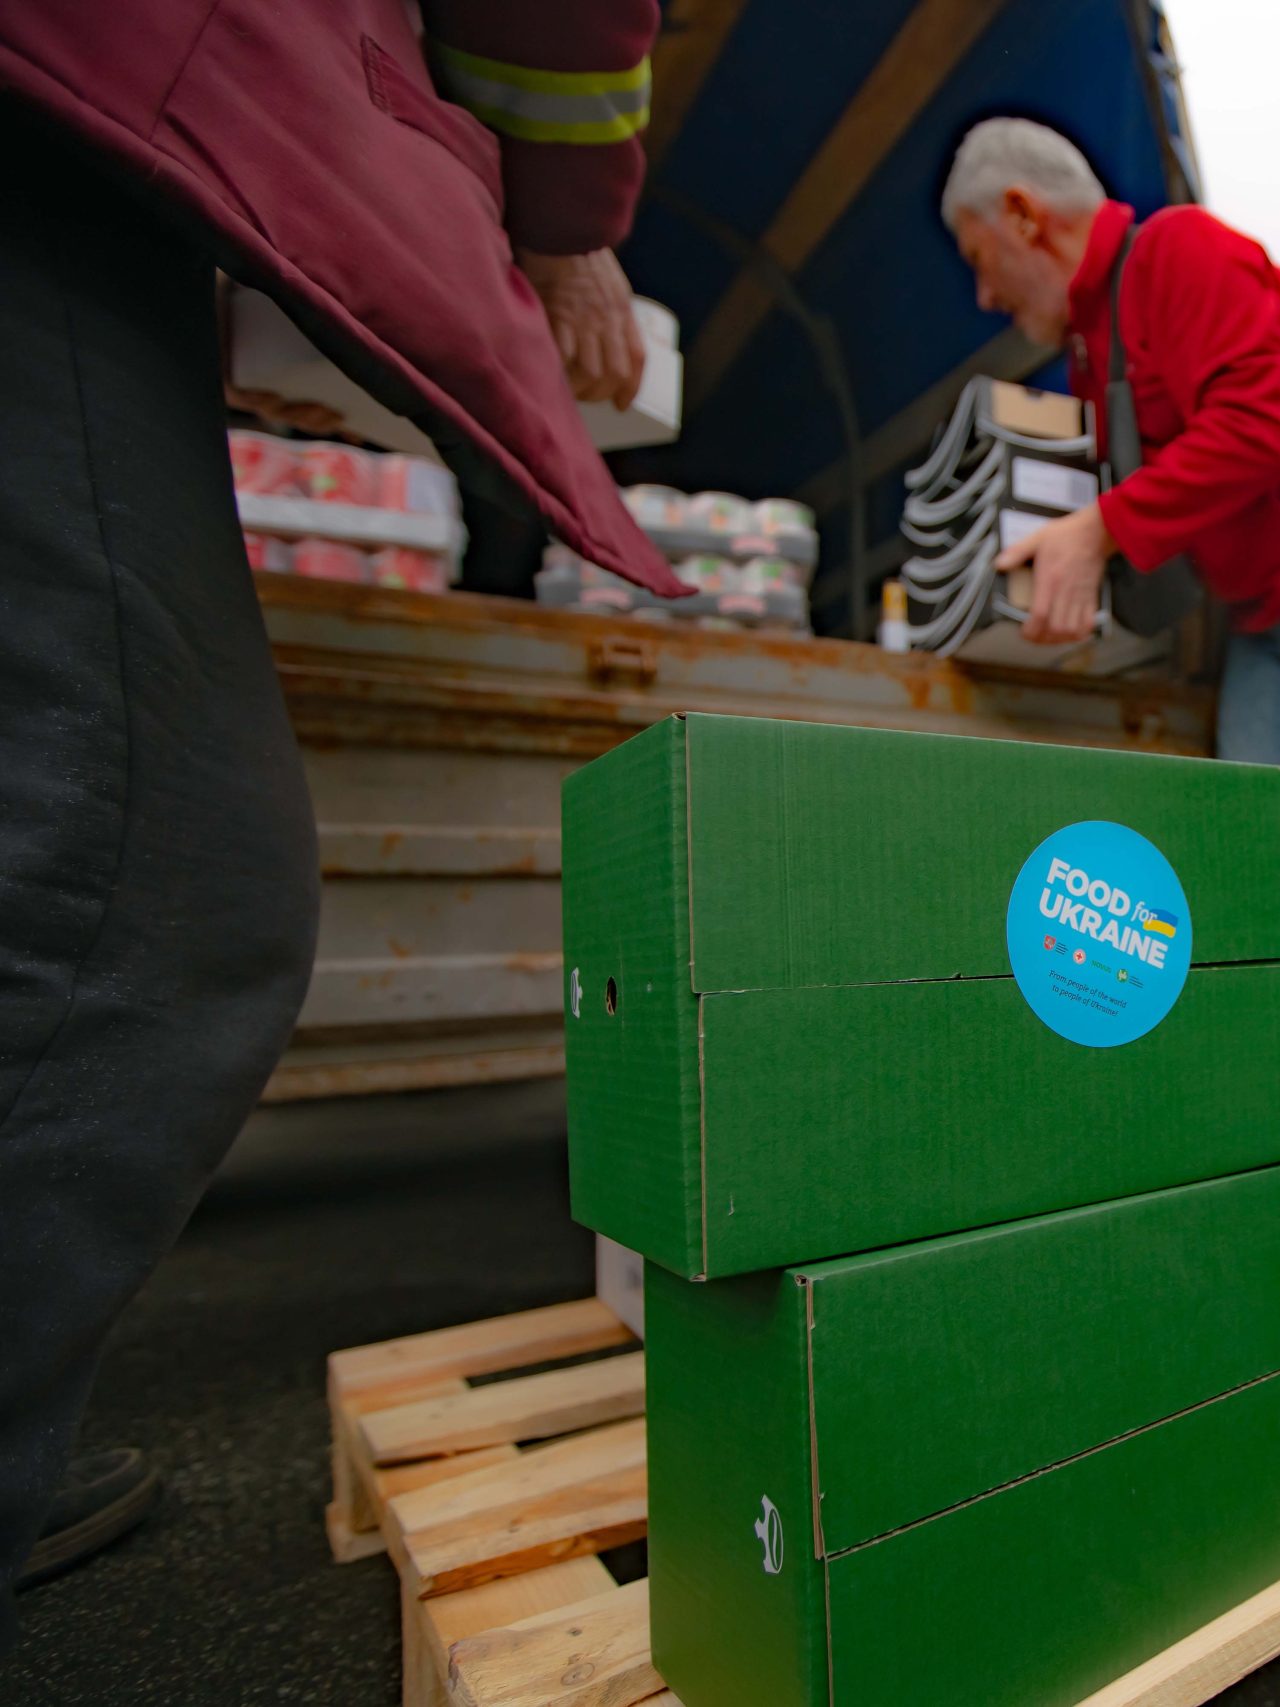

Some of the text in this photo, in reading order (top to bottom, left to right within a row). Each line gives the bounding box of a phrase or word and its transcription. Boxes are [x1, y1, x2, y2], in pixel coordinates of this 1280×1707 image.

[1046, 857, 1158, 925] FOOD for
[1039, 887, 1168, 970] UKRAINE
[1049, 970, 1128, 1008] From people of the world
[1052, 985, 1059, 993] to
[1059, 989, 1082, 1002] people
[1082, 998, 1091, 1007] of
